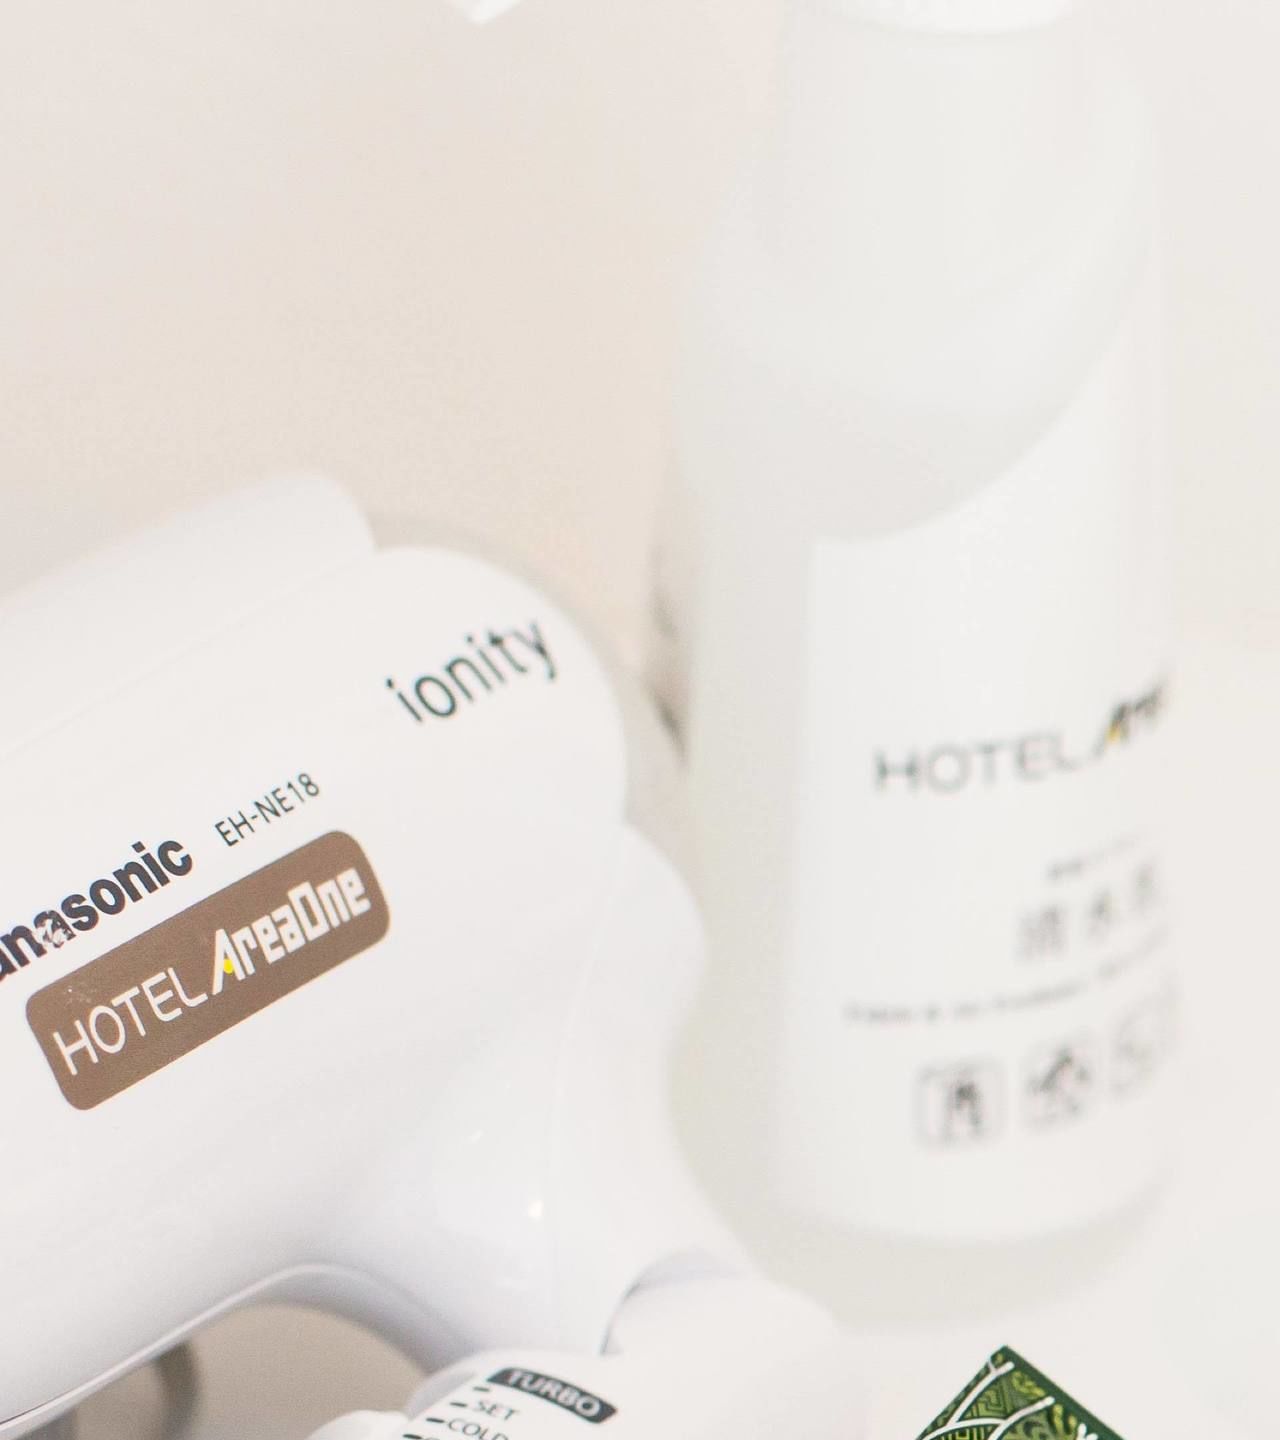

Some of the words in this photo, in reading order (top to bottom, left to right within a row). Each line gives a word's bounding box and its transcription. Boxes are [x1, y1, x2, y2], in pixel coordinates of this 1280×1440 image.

[385, 621, 557, 723] ionity
[871, 730, 1086, 797] HOTEL
[214, 772, 320, 847] EH-NE18
[53, 966, 208, 1077] HOTEL
[211, 866, 372, 996] AreaOne
[472, 1399, 519, 1421] SET
[509, 1369, 602, 1418] TURBO
